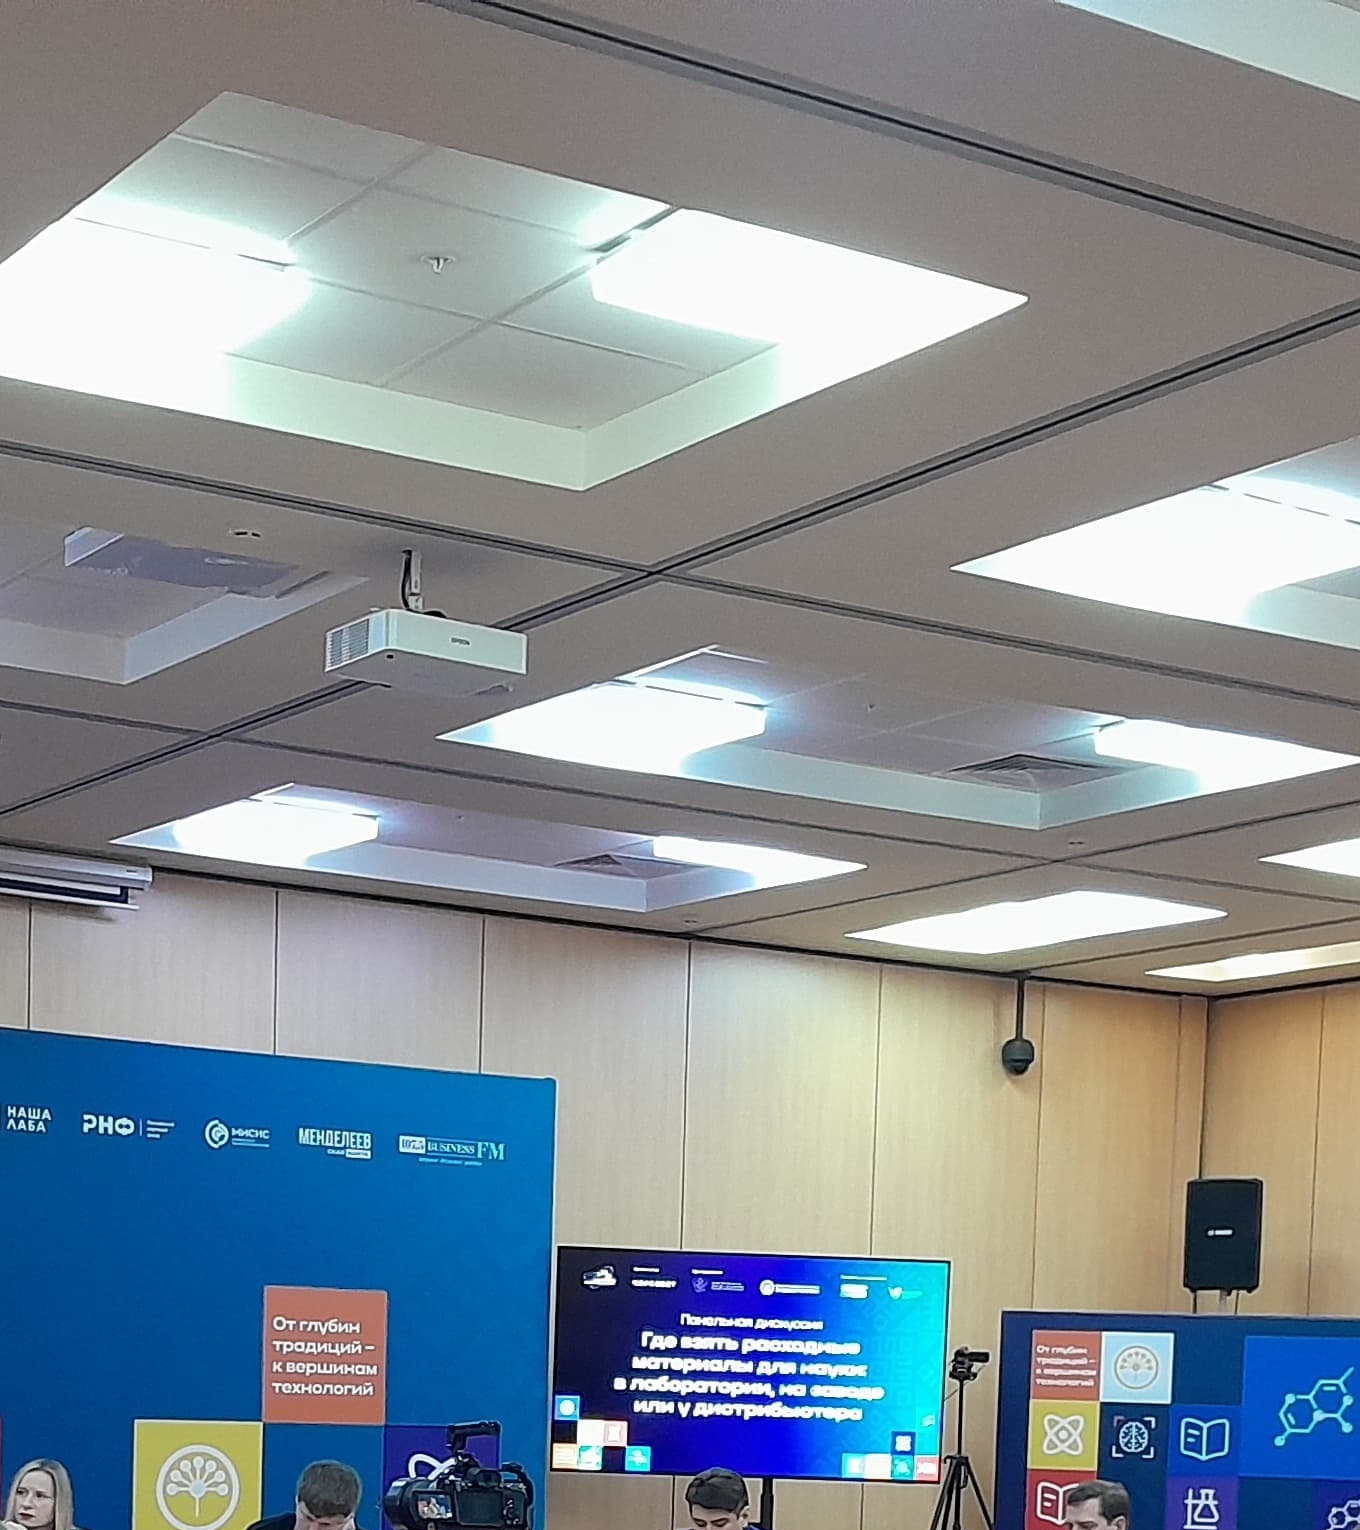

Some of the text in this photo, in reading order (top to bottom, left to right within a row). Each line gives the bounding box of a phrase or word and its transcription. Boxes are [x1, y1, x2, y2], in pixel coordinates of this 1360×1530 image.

[7, 1105, 52, 1121] НАША
[7, 1118, 47, 1133] ЛАБА
[82, 1114, 135, 1136] РНФ
[299, 1127, 371, 1149] МЕНДЕЛЕЕВ
[427, 1141, 475, 1154] BUSINESS
[477, 1142, 505, 1160] FM
[272, 1316, 360, 1335] От глубин
[272, 1340, 362, 1356] традиций
[641, 1331, 860, 1355] Где взять расходные
[272, 1361, 377, 1376] к вершинам
[632, 1356, 753, 1374] материалы
[756, 1361, 796, 1376] для
[271, 1382, 374, 1395] технологий
[613, 1377, 627, 1391] в
[630, 1376, 775, 1398] лаборатории,
[778, 1384, 806, 1397] на
[633, 1400, 674, 1414] или
[677, 1403, 690, 1418] у
